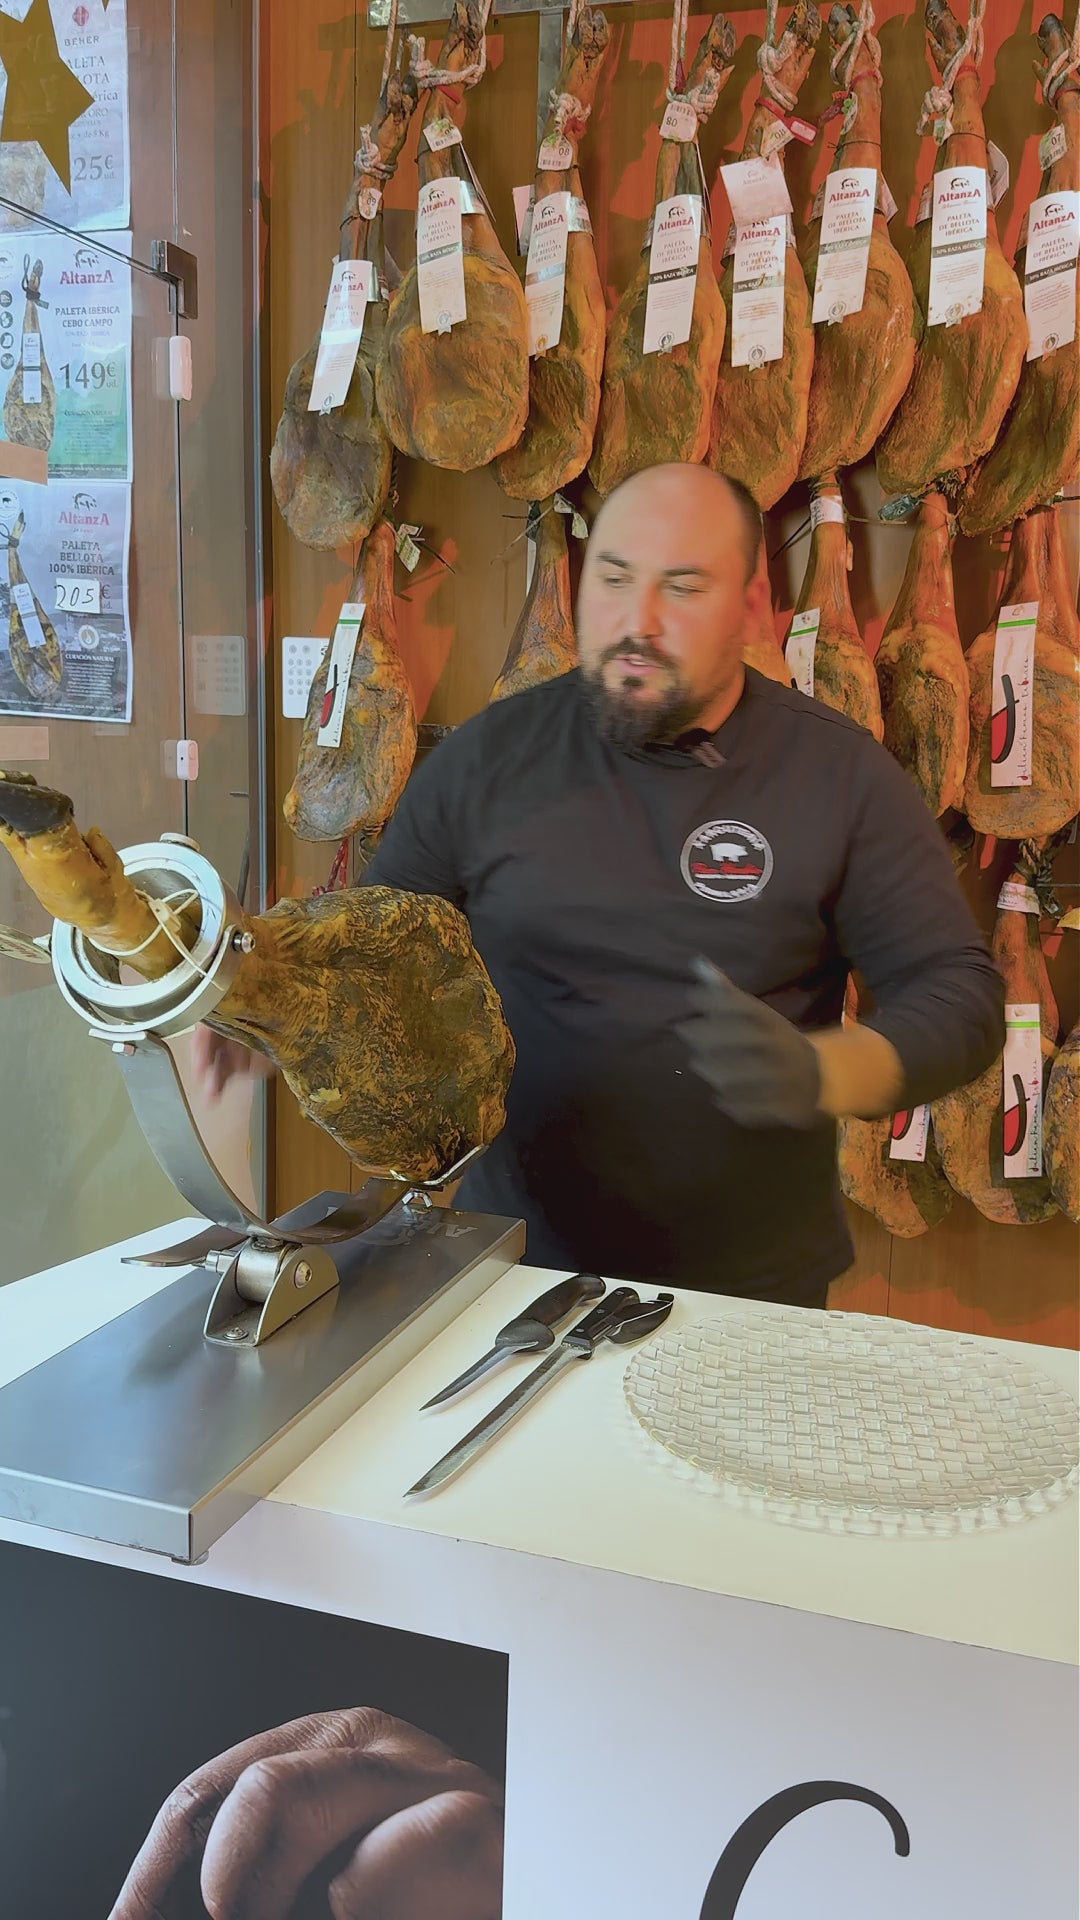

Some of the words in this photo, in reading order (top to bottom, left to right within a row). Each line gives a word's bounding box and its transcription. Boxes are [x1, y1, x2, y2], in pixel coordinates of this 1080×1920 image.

[64, 35, 99, 46] BEHER
[67, 56, 105, 69] ALETA
[829, 188, 870, 203] AltanzA
[938, 188, 982, 204] AltanzA
[421, 197, 456, 216] AltanzA
[836, 211, 860, 220] PALETA
[947, 212, 972, 221] PALETA
[1032, 211, 1076, 232] AltanzA
[533, 214, 565, 234] AltanzA
[657, 215, 695, 233] AltanzA
[950, 218, 980, 229] BELLOTA
[741, 227, 781, 241] AltanzA
[1041, 237, 1065, 249] PALETA
[1044, 242, 1073, 256] BELLOTA
[59, 269, 114, 285] AltanzA
[55, 307, 87, 316] PALETA
[62, 319, 83, 328] CEBO
[84, 319, 113, 328] CAMPO
[59, 511, 110, 526] AltanzA
[61, 541, 101, 551] PALETA
[59, 552, 104, 562] BELLOTA
[49, 563, 74, 574] 100%
[54, 584, 95, 609] 205
